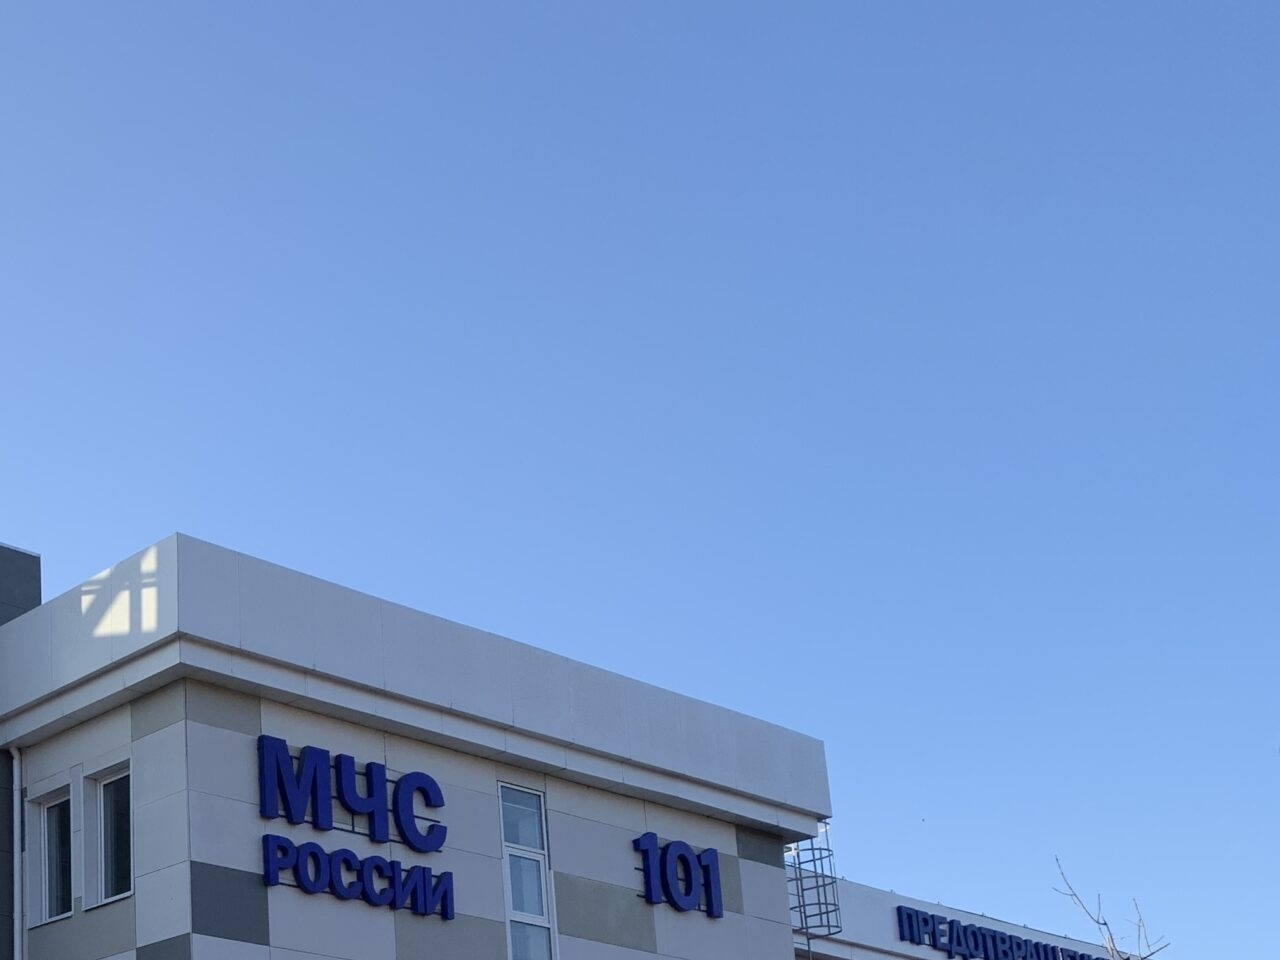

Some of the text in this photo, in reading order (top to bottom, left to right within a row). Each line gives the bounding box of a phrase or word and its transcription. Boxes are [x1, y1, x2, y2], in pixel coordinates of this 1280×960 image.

[257, 734, 447, 853] МЧС
[261, 833, 455, 920] РОССИИ
[633, 832, 724, 919] 101
